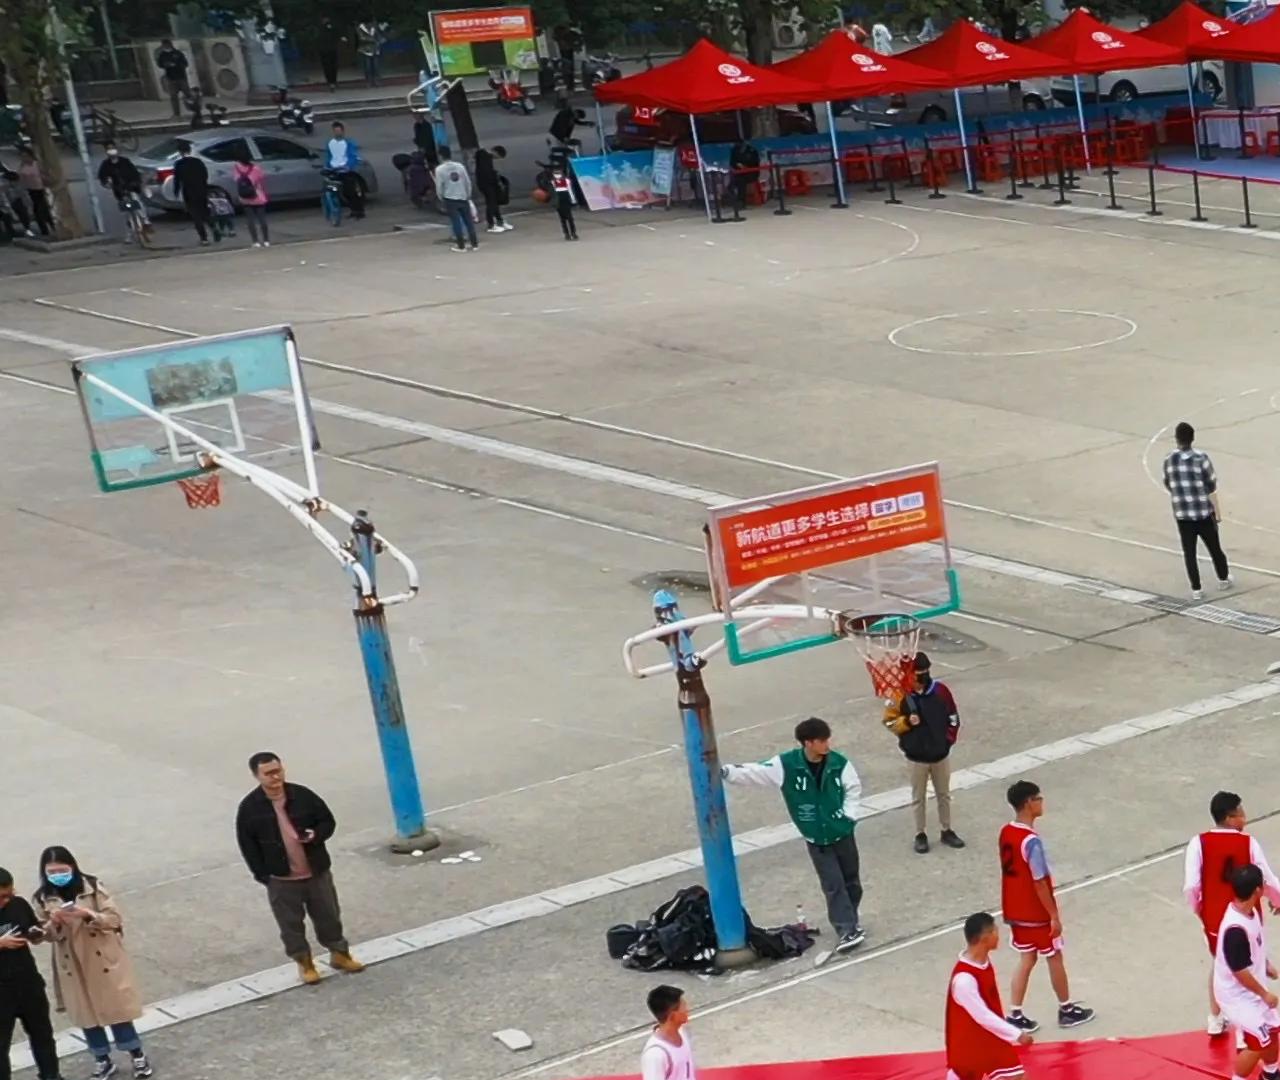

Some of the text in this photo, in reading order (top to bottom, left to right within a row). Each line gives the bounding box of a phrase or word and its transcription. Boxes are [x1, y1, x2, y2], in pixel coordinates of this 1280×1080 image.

[735, 502, 871, 548] 新航道更多学生选择
